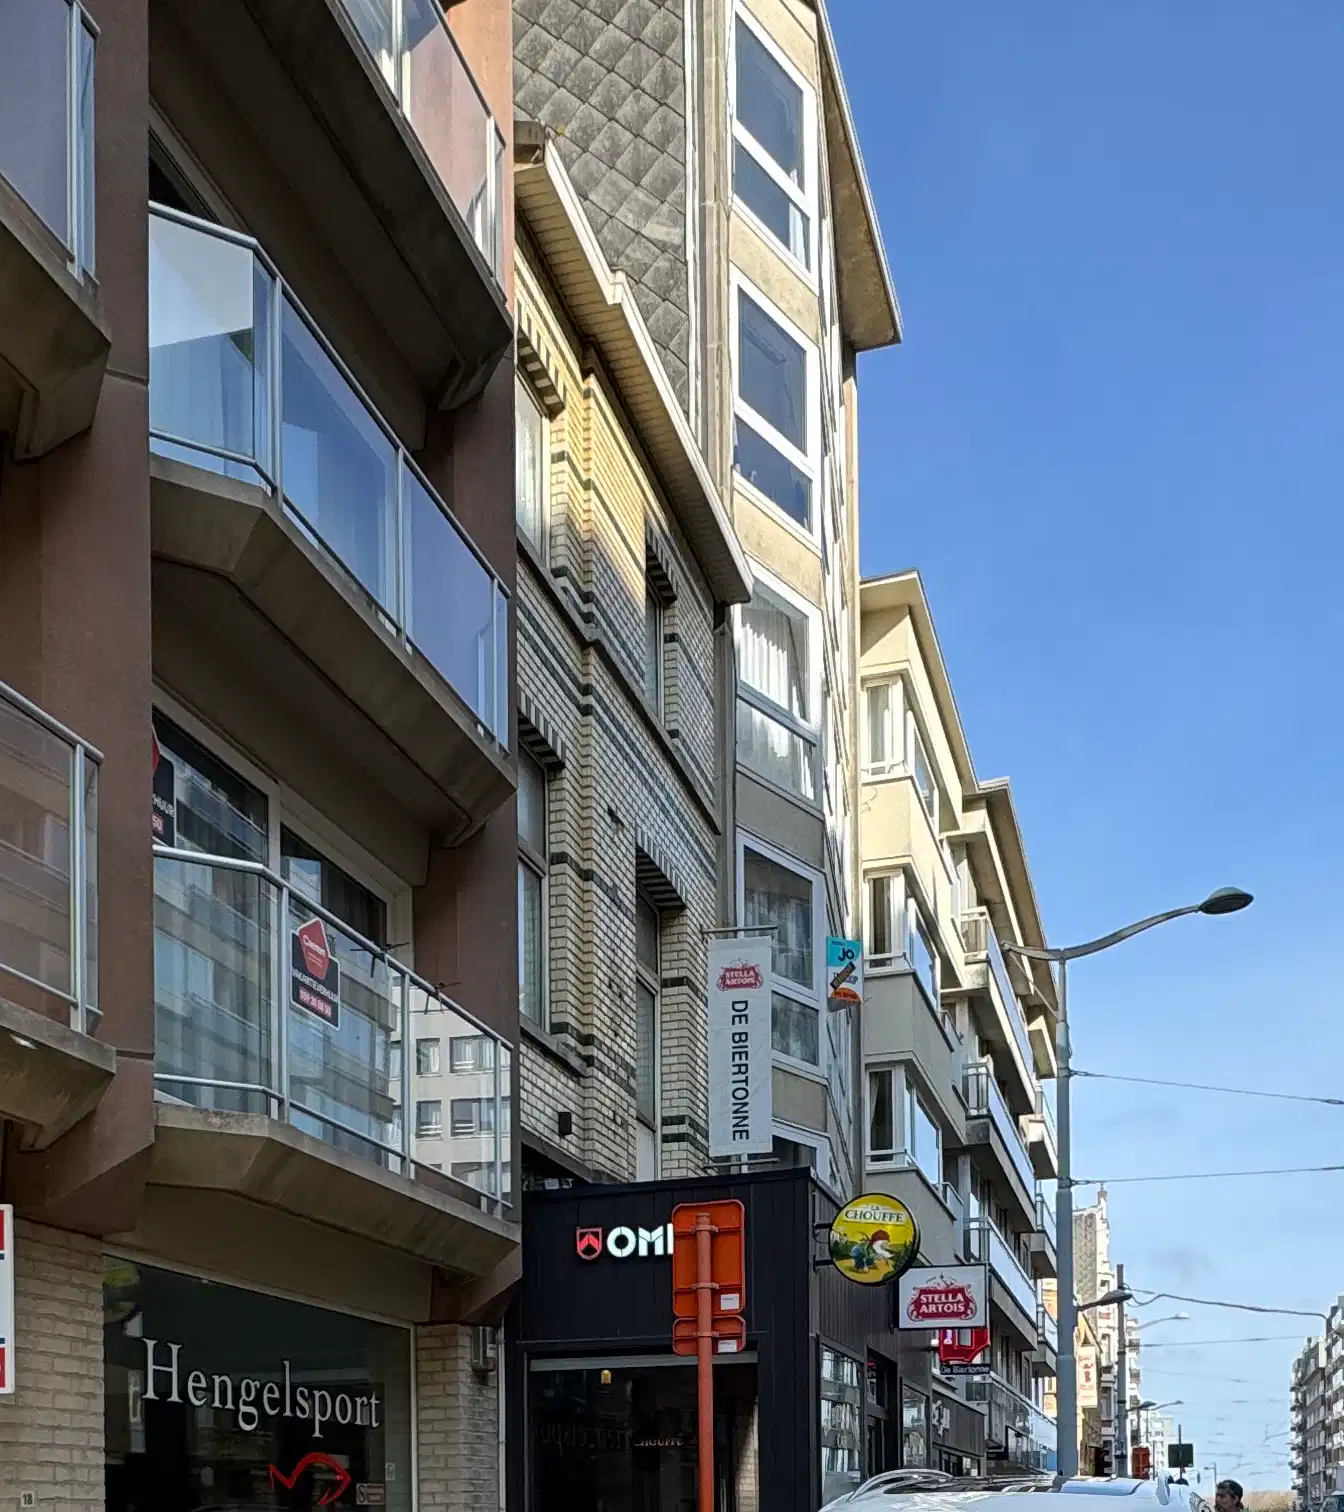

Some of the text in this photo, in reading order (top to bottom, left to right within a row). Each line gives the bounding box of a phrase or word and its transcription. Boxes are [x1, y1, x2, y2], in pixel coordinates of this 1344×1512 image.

[725, 977, 756, 986] ARTOIS
[731, 1000, 750, 1142] DE BIERTONNE
[844, 1209, 904, 1223] CHOUFFE
[919, 1293, 965, 1303] STELLA
[919, 1303, 965, 1314] ARTOIS
[141, 1337, 381, 1438] Hengelsport
[22, 1493, 33, 1505] 18
